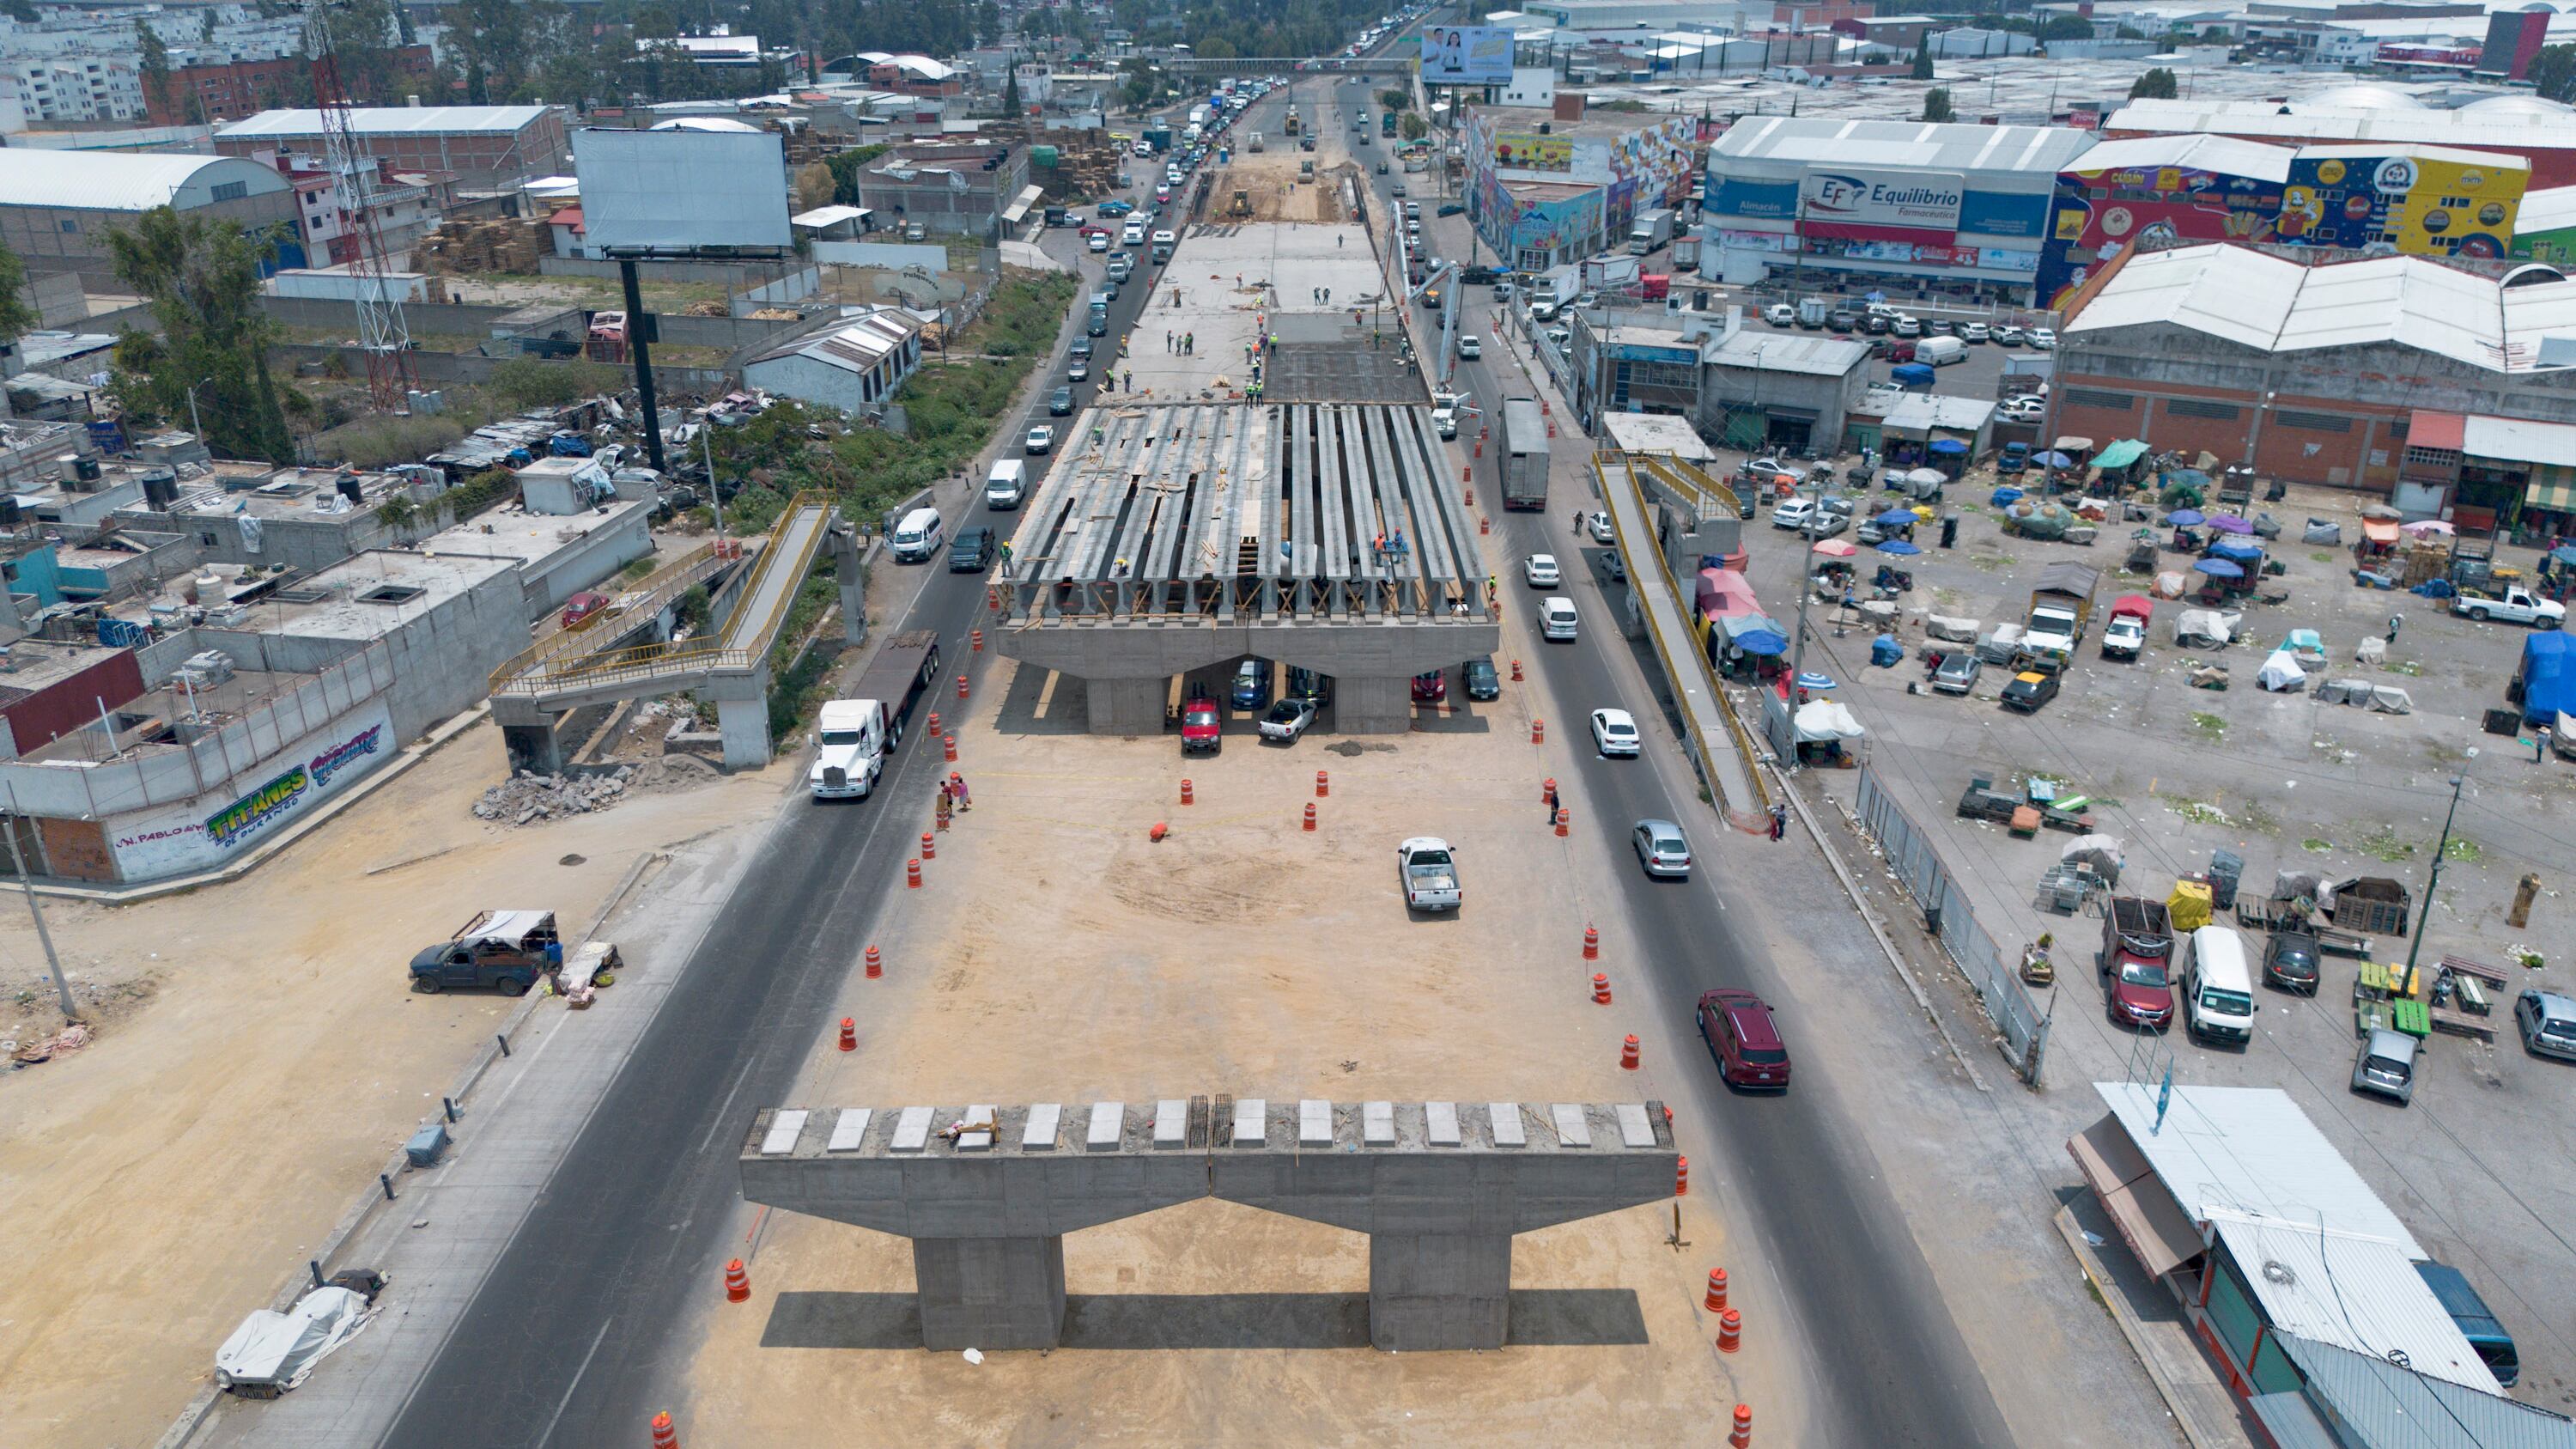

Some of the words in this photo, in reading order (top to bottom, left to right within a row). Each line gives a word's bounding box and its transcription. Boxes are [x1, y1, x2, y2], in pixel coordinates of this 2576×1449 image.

[1871, 184, 1959, 206] Equilibrio
[917, 267, 927, 276] La
[204, 764, 308, 847] TITANES
[224, 836, 237, 848] DE
[240, 797, 299, 837] DURANGO
[137, 827, 183, 843] PABLO
